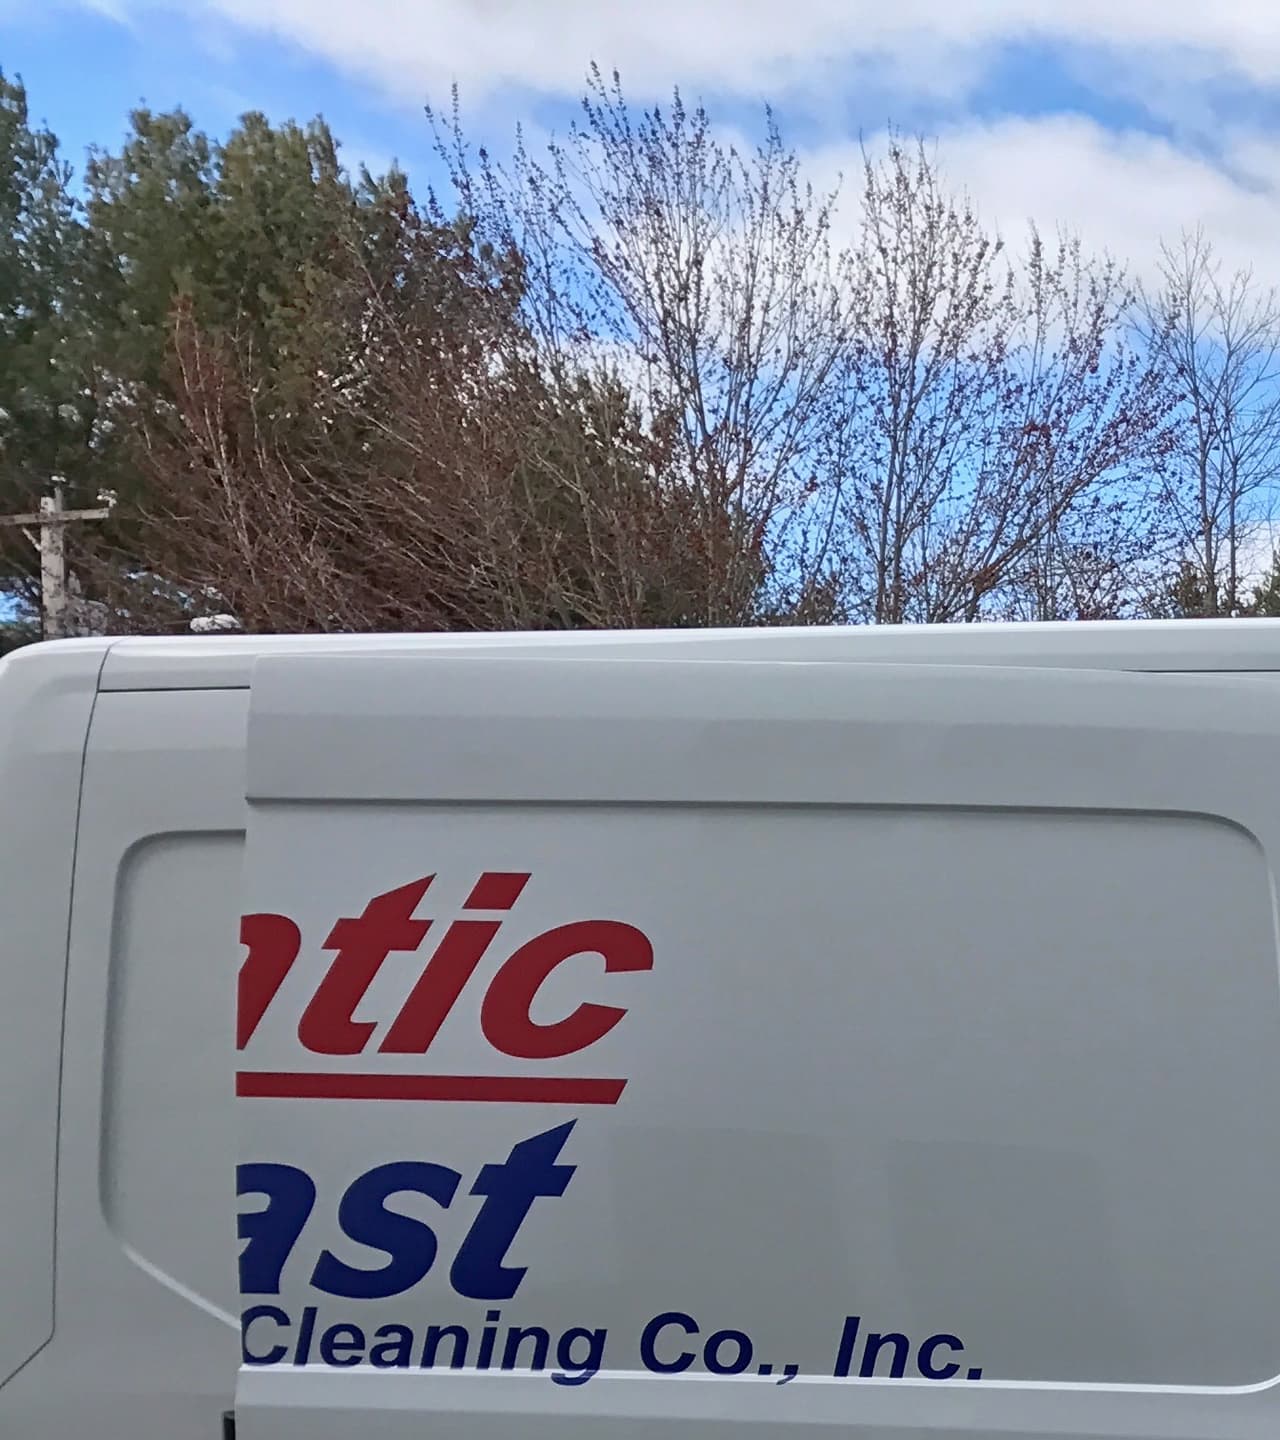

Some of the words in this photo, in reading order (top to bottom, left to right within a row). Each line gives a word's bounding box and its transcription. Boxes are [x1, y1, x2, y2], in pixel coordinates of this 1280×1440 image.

[241, 1304, 609, 1389] Cleaning
[640, 1311, 799, 1387] Co.,
[834, 1316, 985, 1383] Inc.
